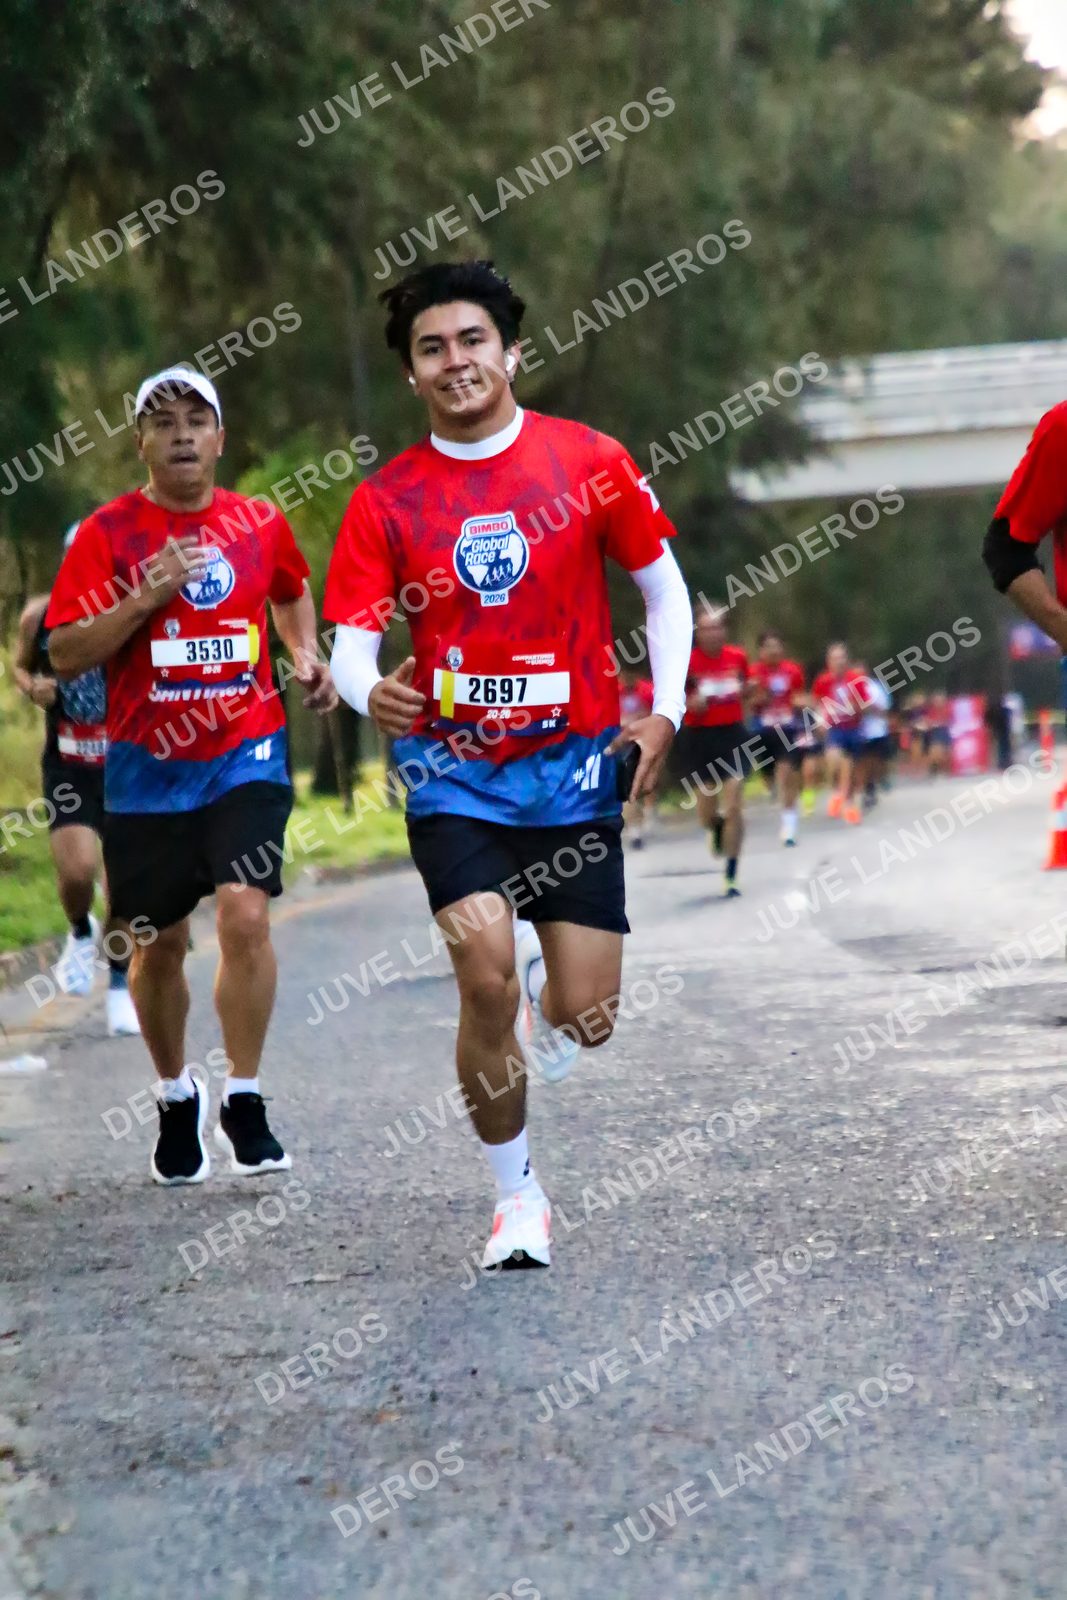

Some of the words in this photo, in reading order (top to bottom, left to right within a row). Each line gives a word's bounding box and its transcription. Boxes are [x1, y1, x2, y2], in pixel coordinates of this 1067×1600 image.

[470, 521, 509, 535] BIMBO
[472, 535, 509, 553] Global
[465, 551, 496, 566] Race
[484, 593, 506, 604] 2026
[186, 638, 234, 663] 3530
[468, 677, 528, 704] 2697
